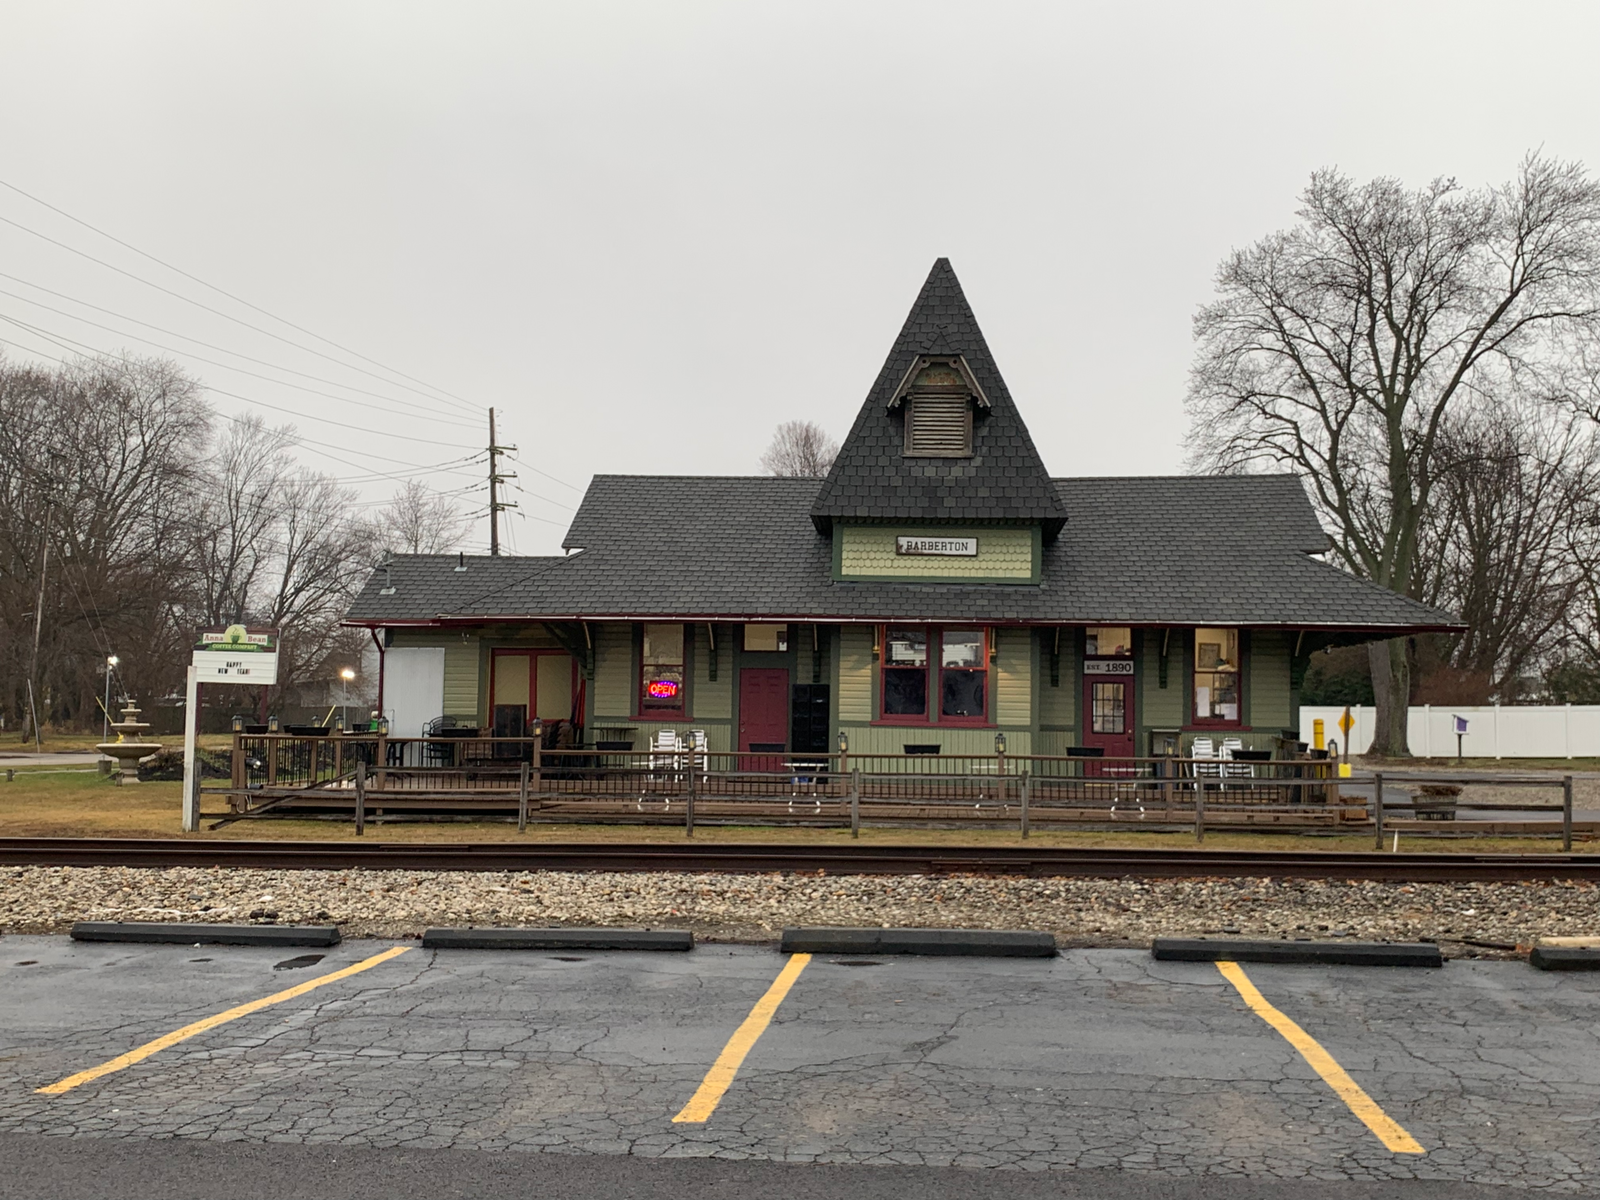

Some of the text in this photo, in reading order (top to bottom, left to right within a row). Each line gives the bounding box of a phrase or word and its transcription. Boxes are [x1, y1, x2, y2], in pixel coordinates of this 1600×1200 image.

[906, 541, 968, 551] BARBERTON
[204, 634, 267, 643] Anna Bean
[1105, 663, 1131, 672] 1890
[650, 684, 676, 696] OPEN
